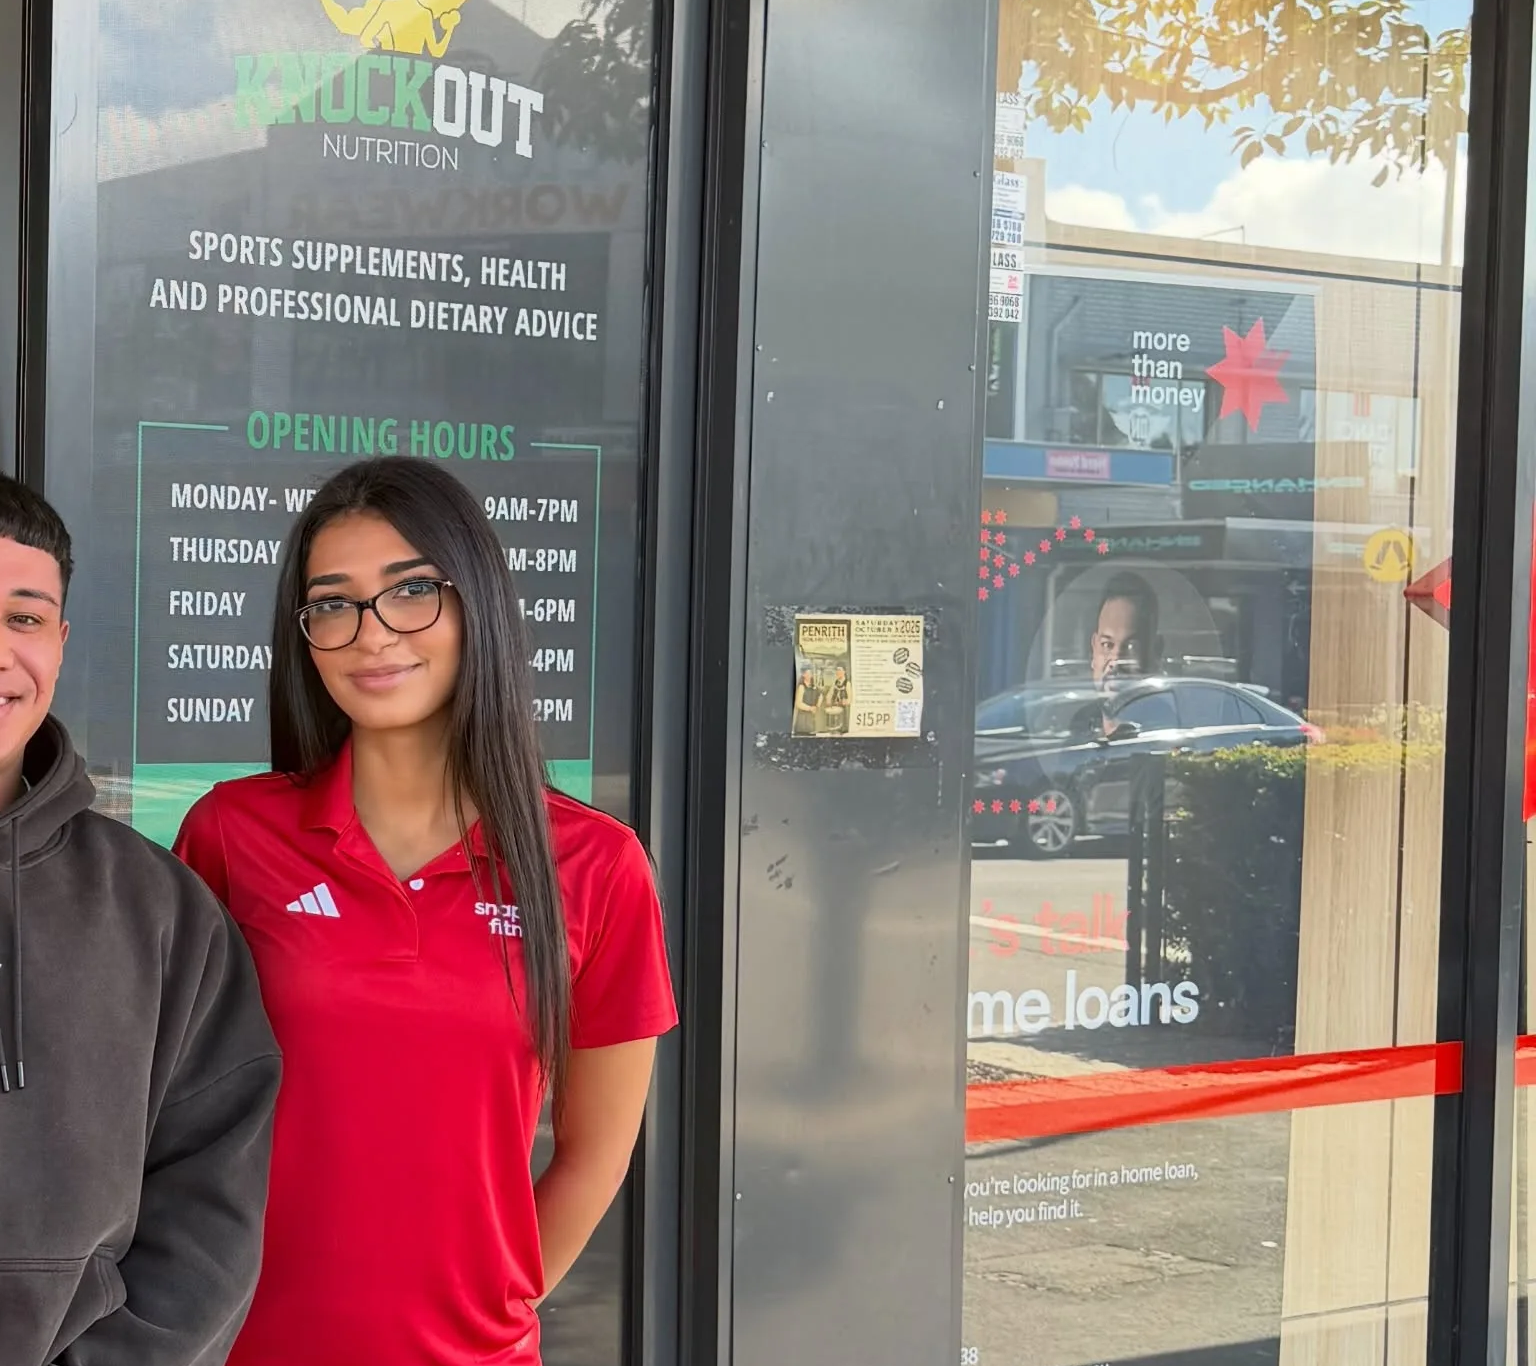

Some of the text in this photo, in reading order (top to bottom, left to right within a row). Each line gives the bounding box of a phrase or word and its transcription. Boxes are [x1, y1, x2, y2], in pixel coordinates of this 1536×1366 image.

[233, 51, 544, 159] KNOCKOUT
[322, 133, 459, 171] NUTRITION
[189, 230, 567, 292] SPORTS SUPPLEMENTS, HEALTH
[993, 252, 1016, 268] LASS
[150, 278, 598, 341] AND PROFESSIONAL DIETARY ADVICE
[1132, 330, 1190, 352] more
[1131, 354, 1183, 379] than
[1130, 384, 1206, 412] money
[247, 410, 516, 462] OPENING HOURS
[284, 487, 321, 513] WE
[484, 496, 578, 523] 9AM-7PM
[169, 536, 281, 565] THURSDAY
[505, 547, 577, 573] M-8PM
[169, 590, 246, 617] FRIDAY
[518, 598, 576, 623] -6PM
[802, 625, 845, 637] PENRITH
[167, 643, 274, 671] SATURDAY
[166, 697, 254, 723] SUNDAY
[532, 698, 573, 722] 2PM
[967, 968, 1200, 1036] me loans
[1013, 1172, 1069, 1195] looking
[1071, 1169, 1094, 1188] for
[1094, 1168, 1108, 1187] in
[1109, 1172, 1118, 1185] a
[1120, 1165, 1163, 1184] home
[1164, 1161, 1199, 1181] loan,
[968, 1198, 1084, 1229] help you find it.
